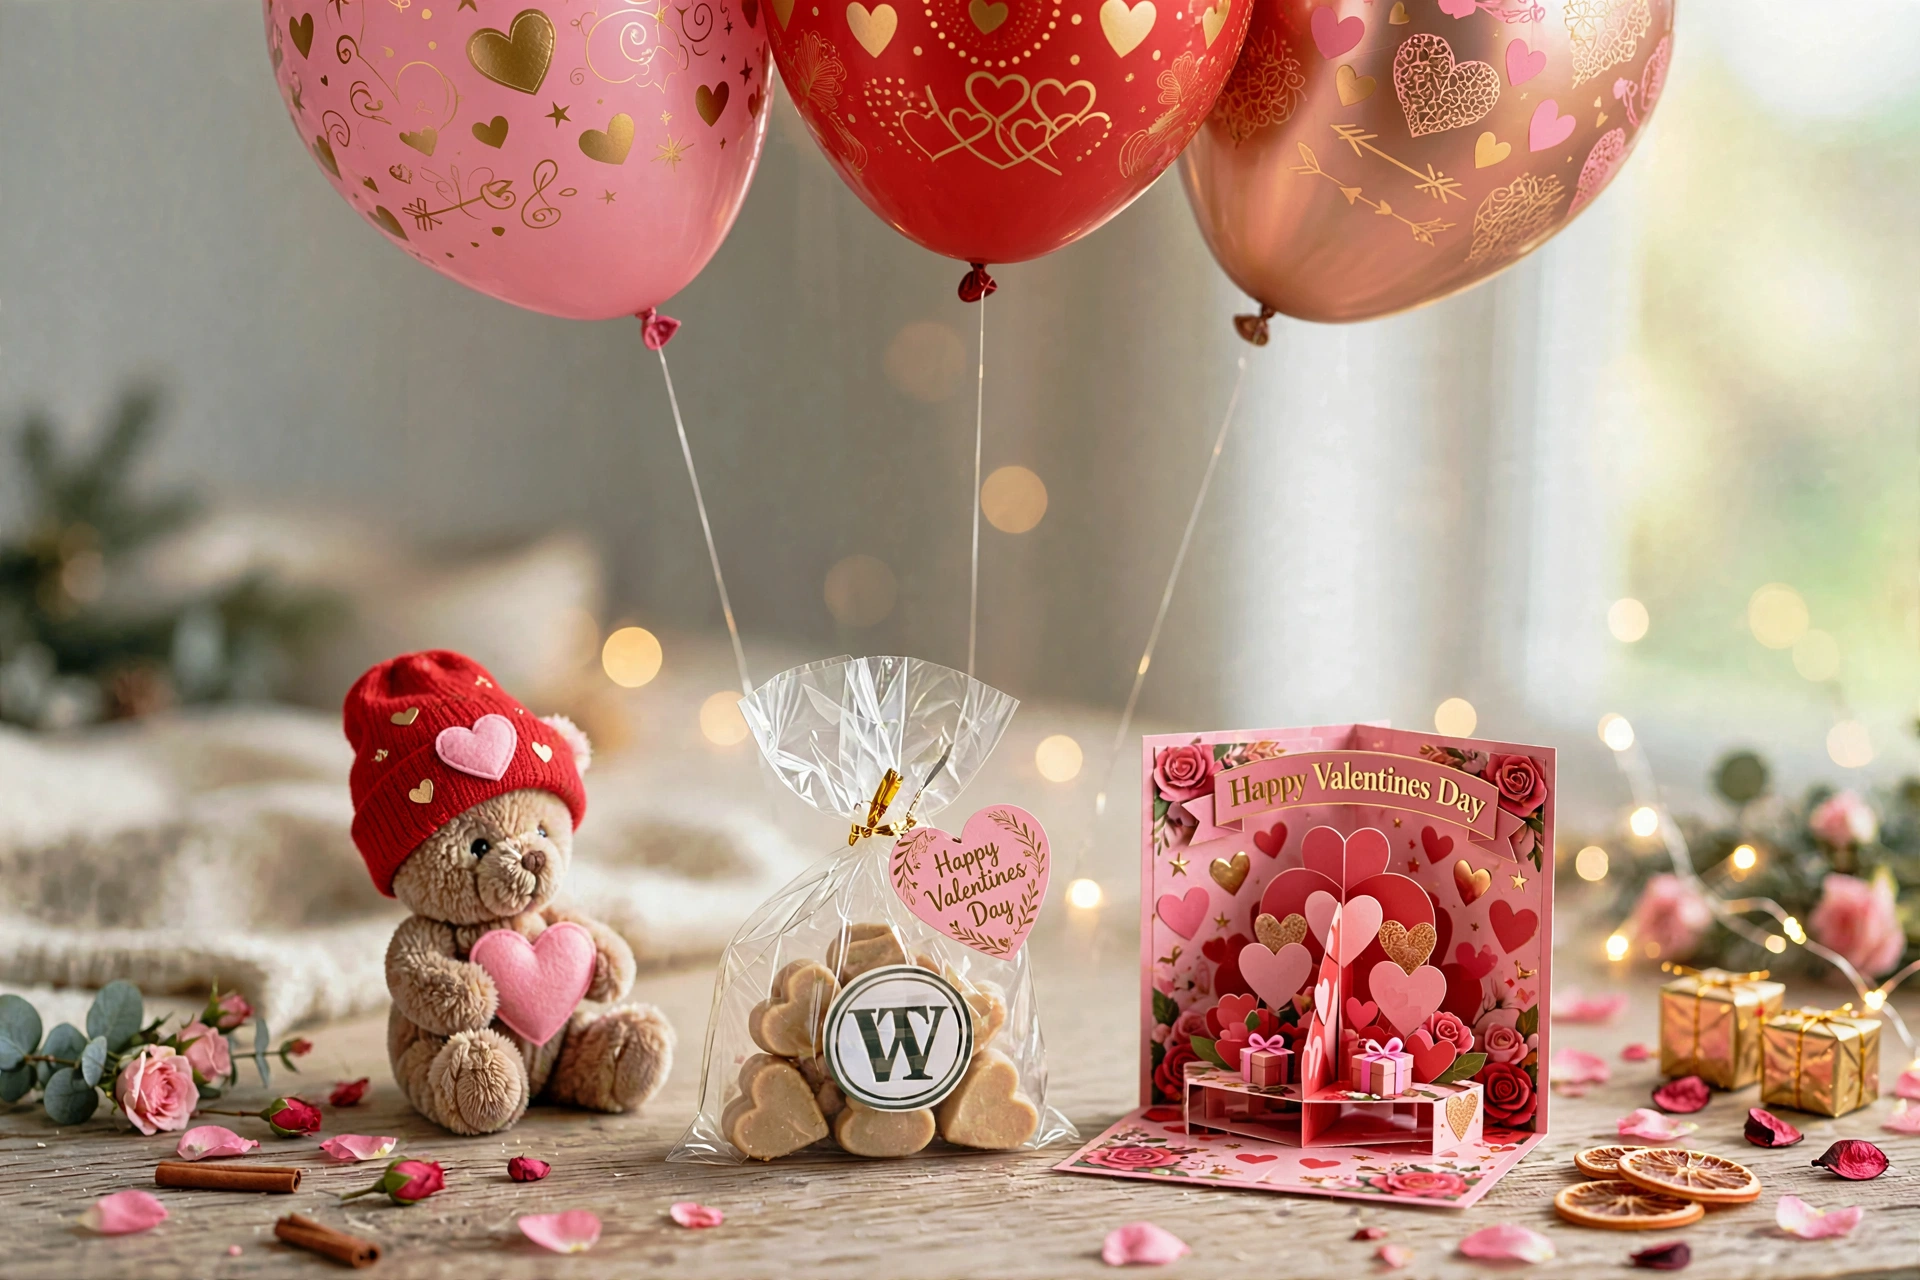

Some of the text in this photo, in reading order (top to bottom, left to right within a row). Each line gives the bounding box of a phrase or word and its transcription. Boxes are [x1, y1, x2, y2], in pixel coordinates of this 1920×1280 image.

[1228, 760, 1486, 823] Happy Valentines Day
[934, 842, 1000, 878] Happy
[923, 862, 1027, 912] Valentines
[966, 900, 1014, 927] Day
